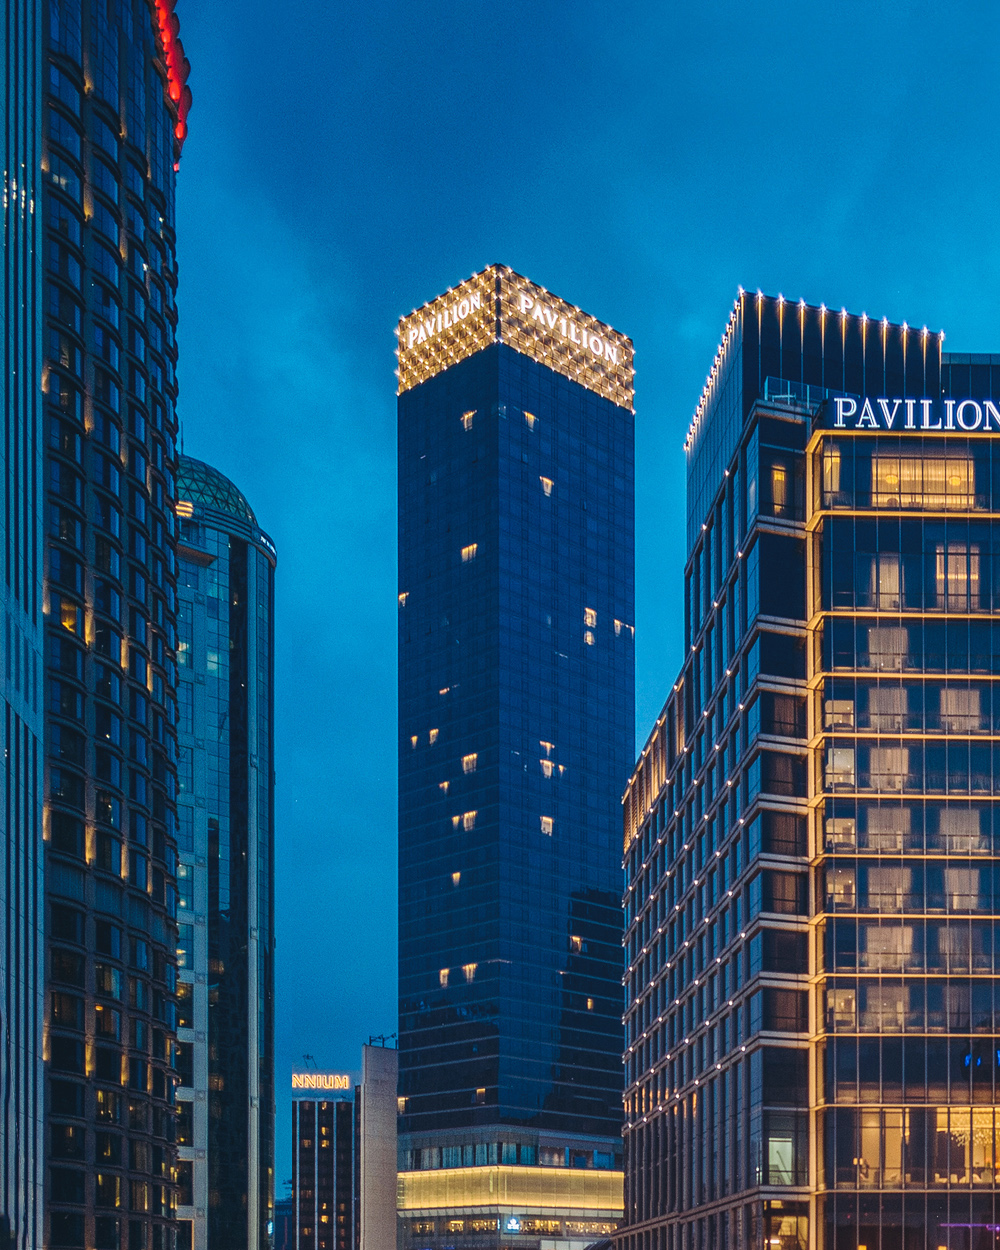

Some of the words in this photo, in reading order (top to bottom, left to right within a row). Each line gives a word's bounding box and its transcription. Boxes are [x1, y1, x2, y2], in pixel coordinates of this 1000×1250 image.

[408, 291, 481, 348] PAVILION
[519, 294, 618, 364] PAVILION
[292, 1073, 349, 1090] NNIUM
